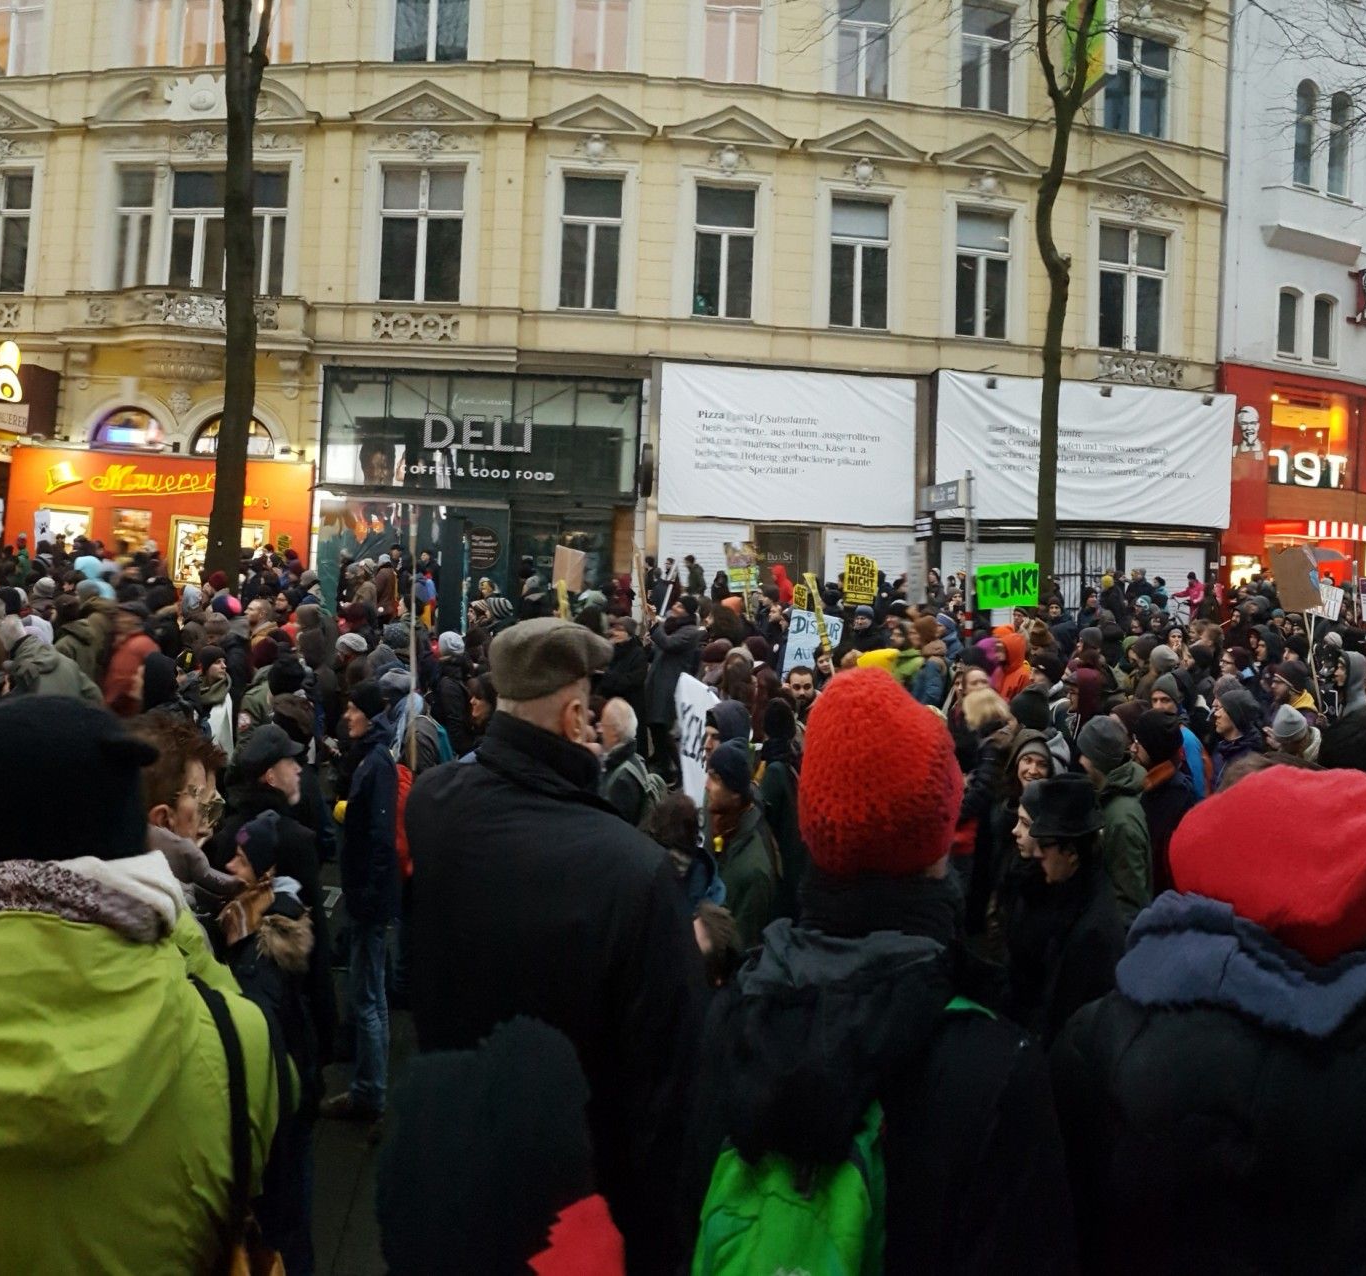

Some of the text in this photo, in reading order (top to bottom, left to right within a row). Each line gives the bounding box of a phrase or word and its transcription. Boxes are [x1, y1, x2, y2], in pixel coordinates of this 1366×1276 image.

[698, 410, 724, 419] Pizza
[423, 412, 534, 454] DELI
[402, 464, 555, 481] COFFEE & GOOD FOOD
[849, 555, 875, 568] LASST
[848, 565, 875, 578] NAZIS
[847, 576, 875, 589] NICHT
